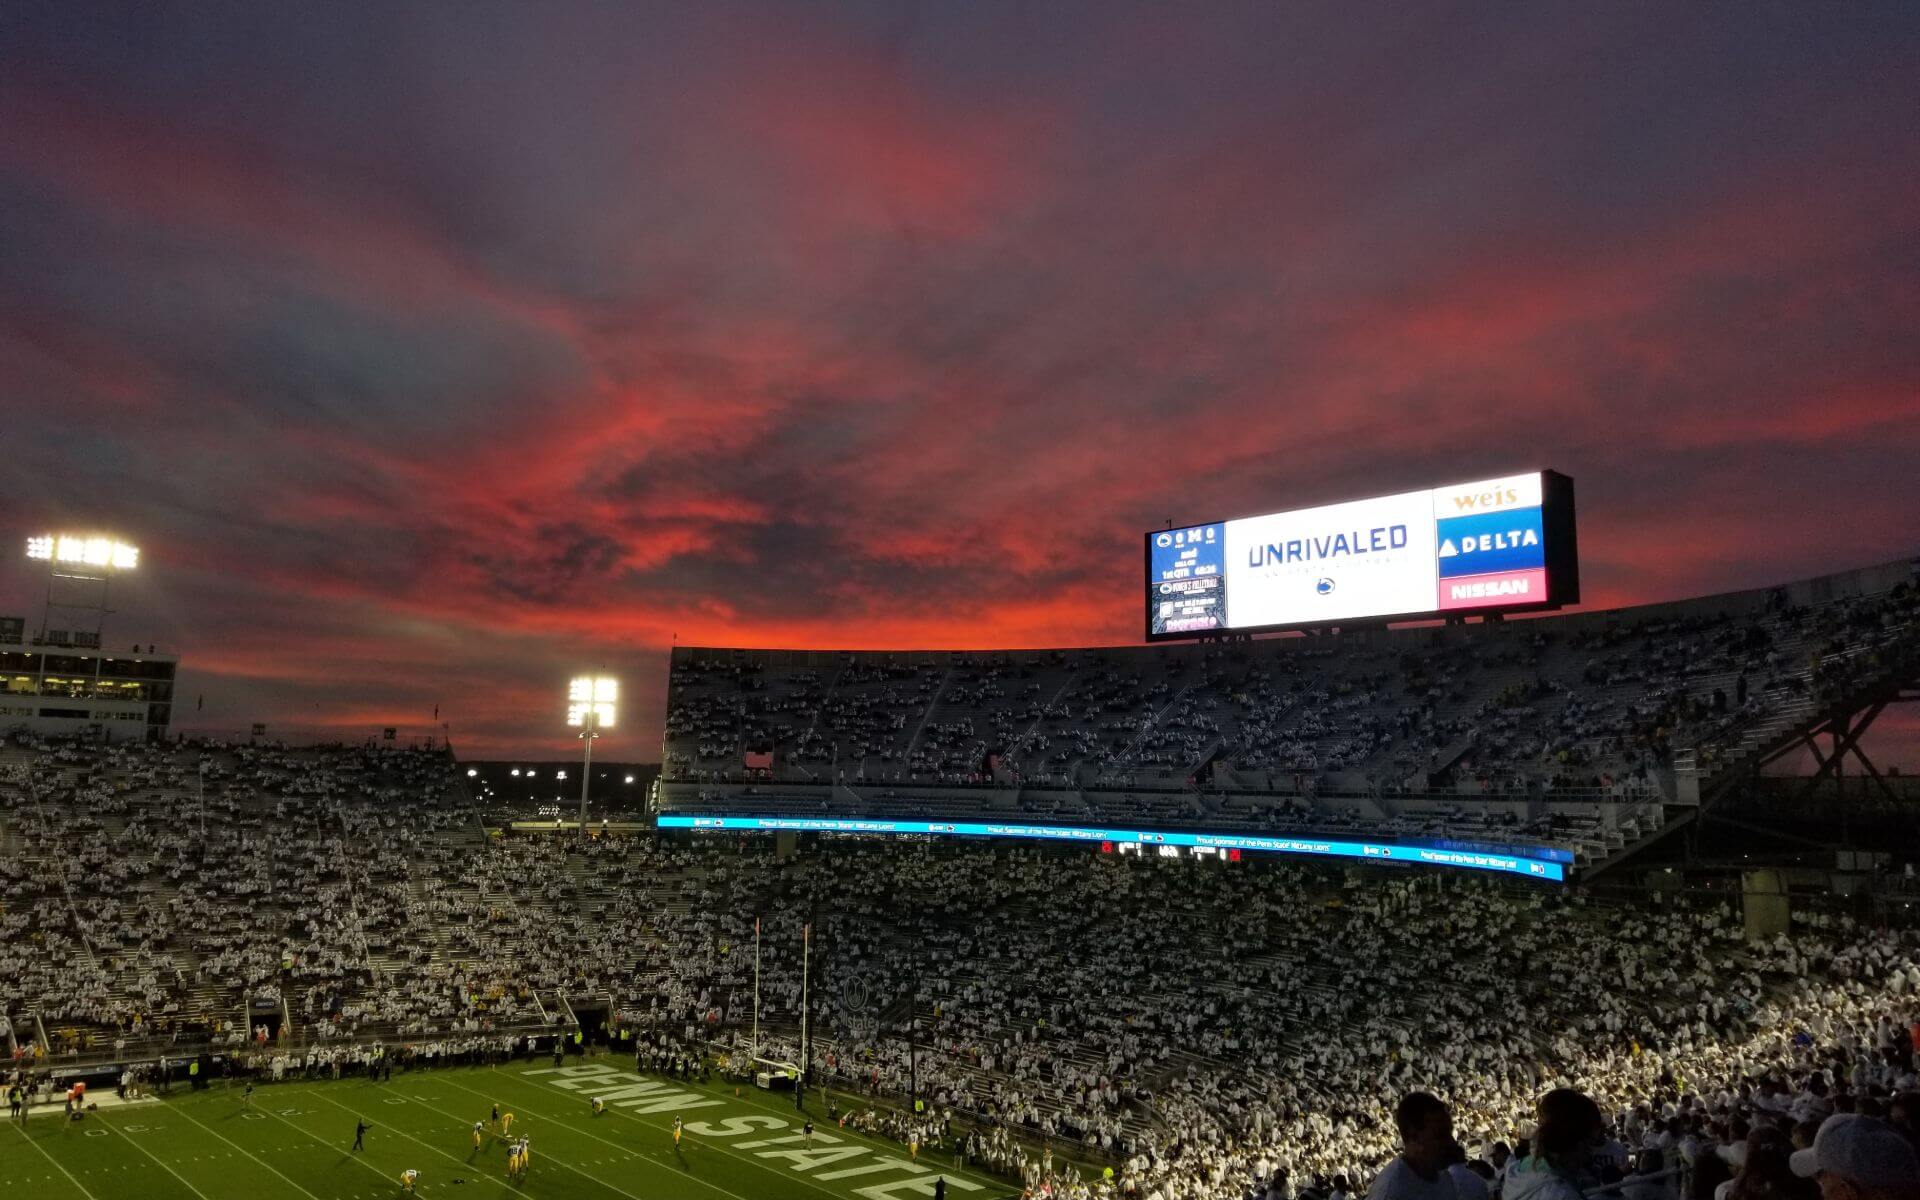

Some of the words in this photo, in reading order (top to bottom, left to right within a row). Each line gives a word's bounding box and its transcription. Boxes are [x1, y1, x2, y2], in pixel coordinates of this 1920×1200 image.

[1455, 485, 1518, 511] weis
[1249, 524, 1408, 568] UNRIVALED
[1461, 529, 1538, 553] DELTA
[1451, 579, 1528, 600] NISSAN
[1247, 839, 1256, 847] the
[521, 1063, 728, 1114] PENN
[684, 1114, 987, 1200] STATE
